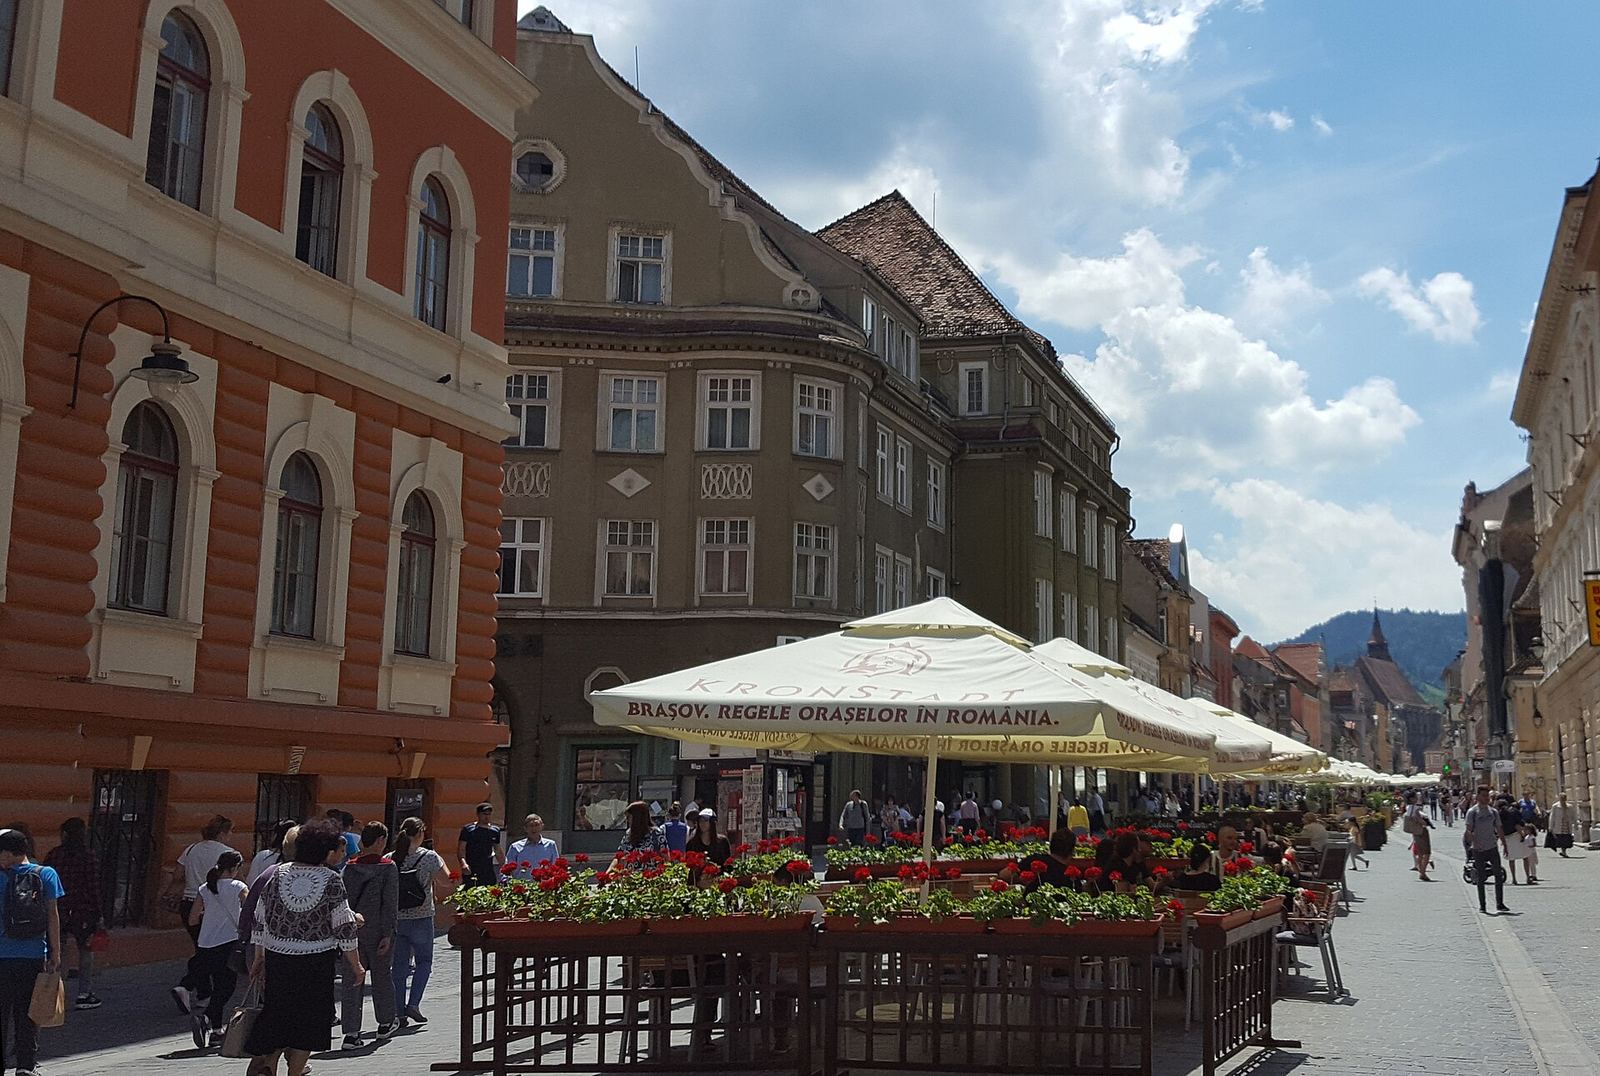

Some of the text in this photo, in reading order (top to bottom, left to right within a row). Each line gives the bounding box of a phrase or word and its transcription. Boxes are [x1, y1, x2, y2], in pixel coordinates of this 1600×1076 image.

[686, 678, 1025, 702] KRONSTADT
[627, 701, 1060, 726] BRAȘOV. REGELE ORAȘELOR ÎN ROMÂNIA.
